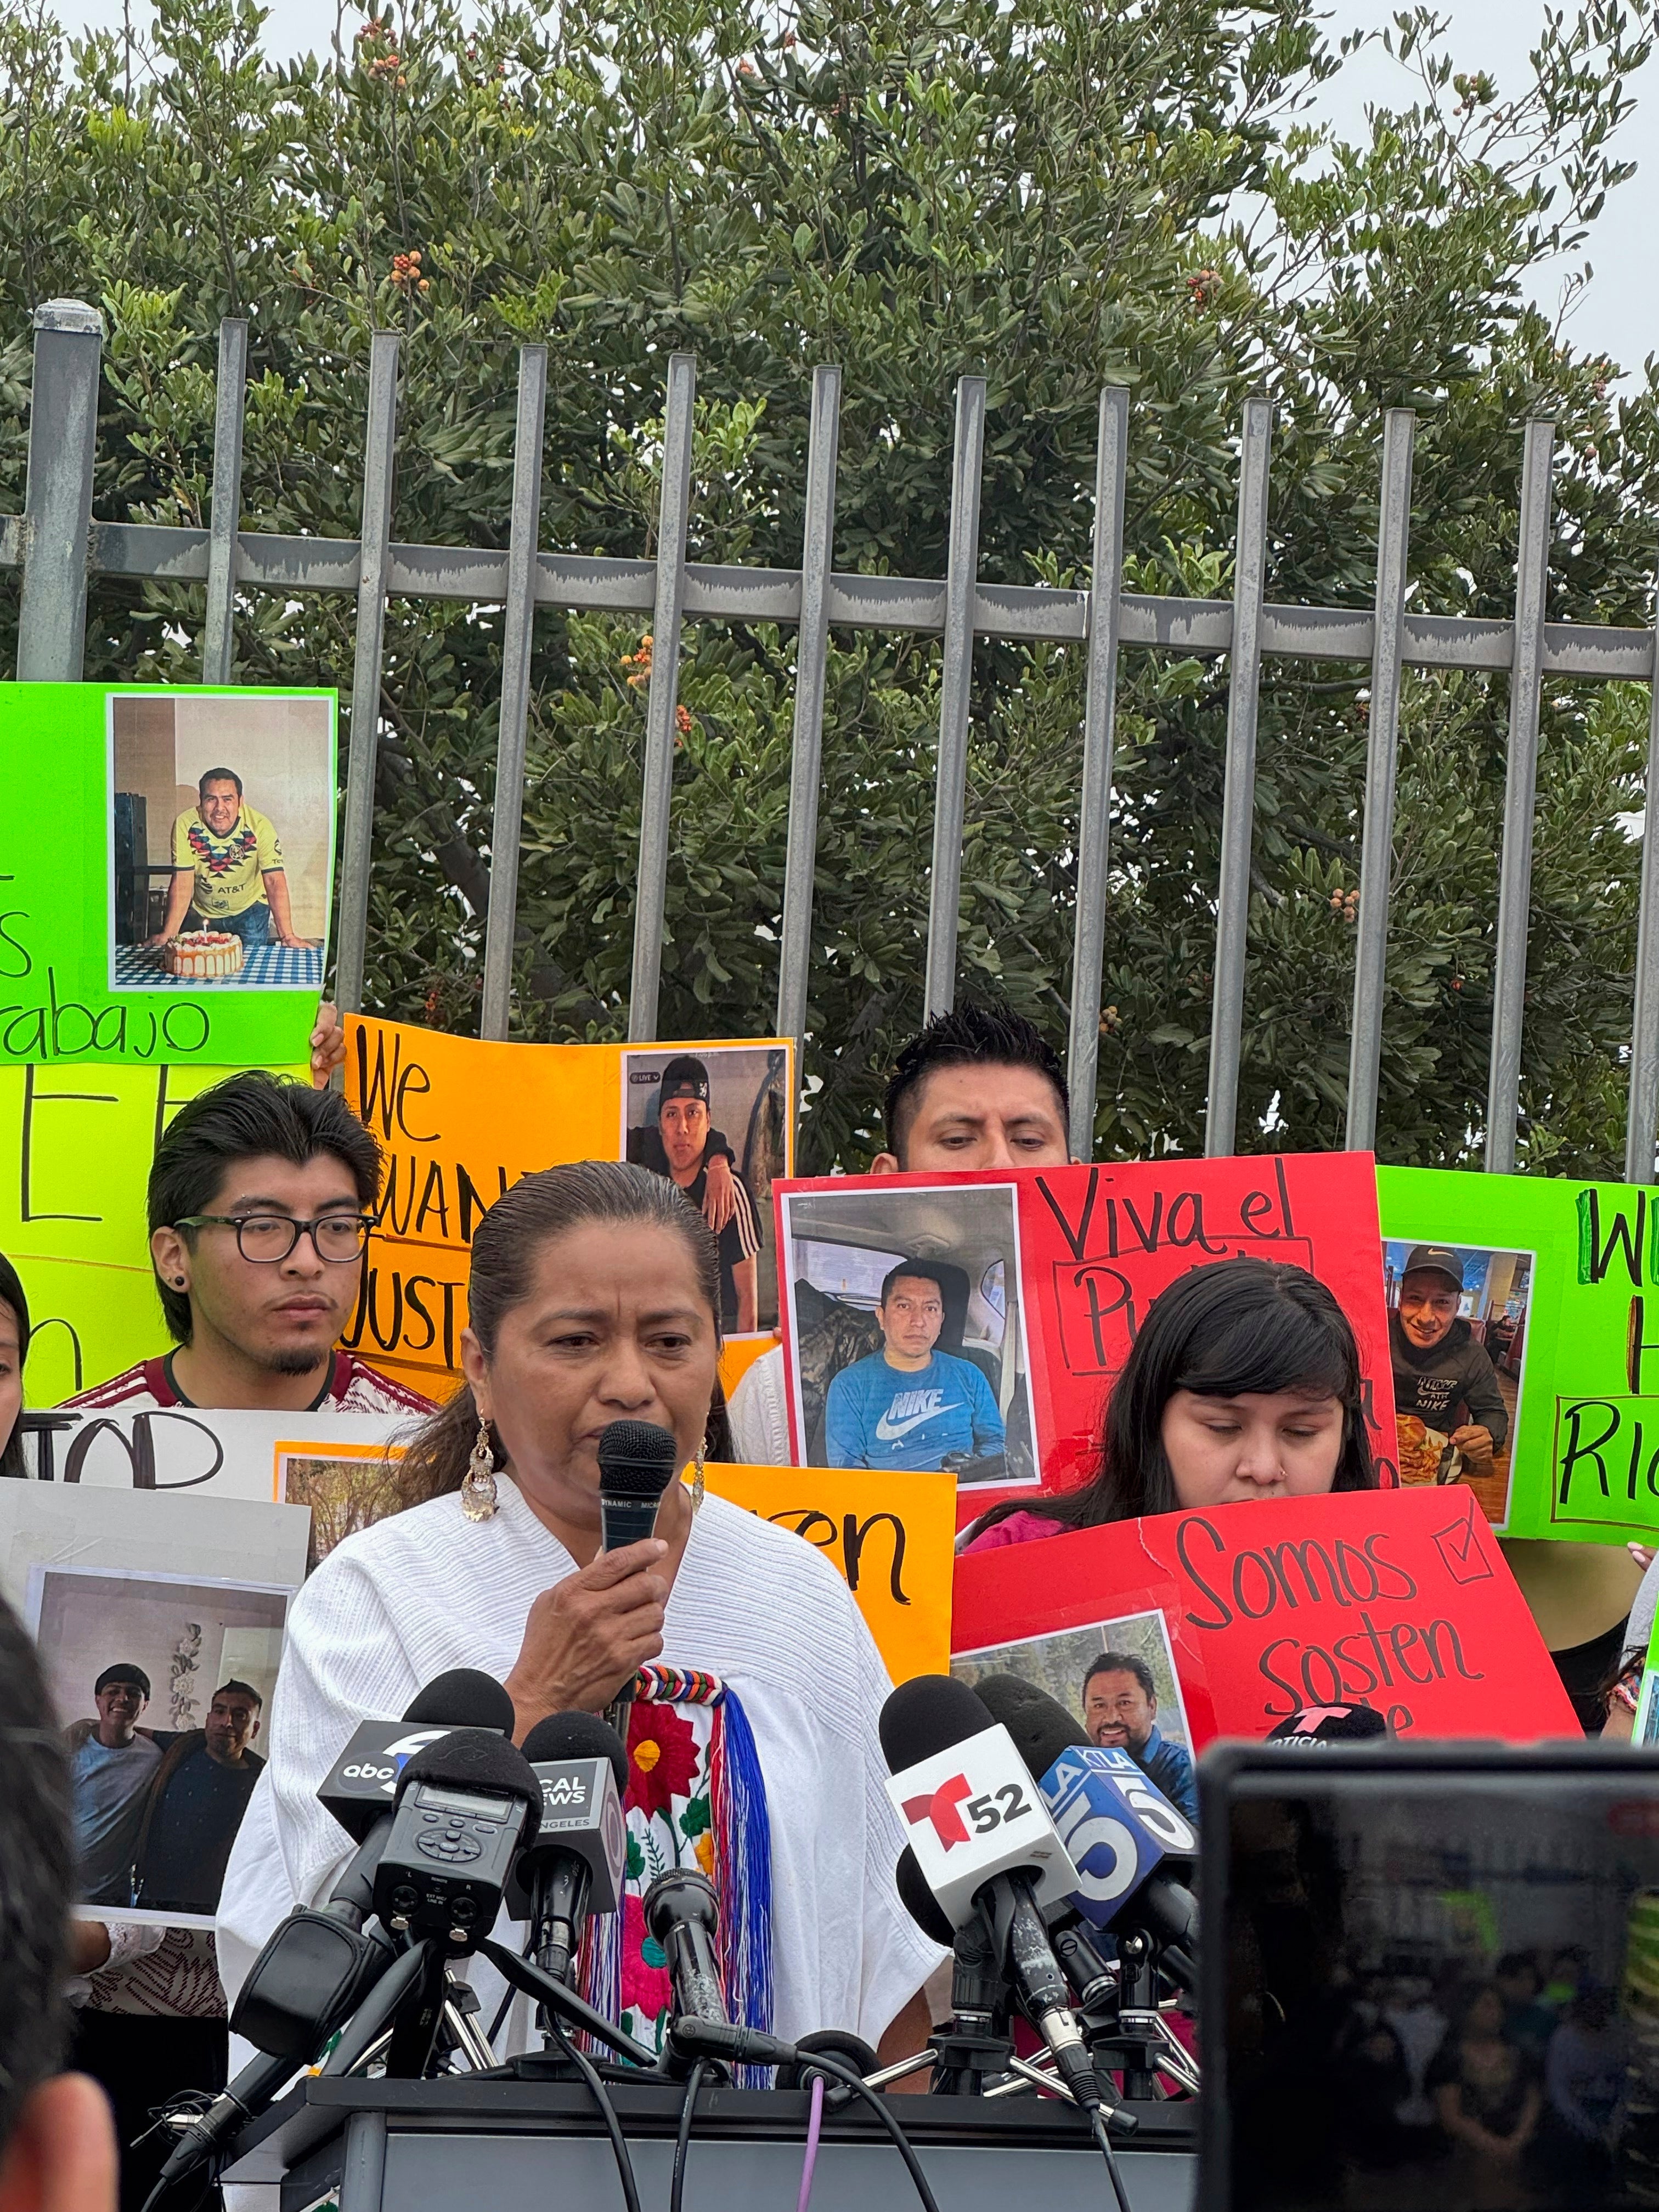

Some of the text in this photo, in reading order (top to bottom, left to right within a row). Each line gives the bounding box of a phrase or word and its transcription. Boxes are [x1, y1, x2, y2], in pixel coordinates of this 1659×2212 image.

[217, 883, 246, 894] AT&T
[356, 1024, 441, 1142] We
[372, 1154, 543, 1244] WAN
[1035, 1157, 1294, 1261] Viva el
[888, 1389, 944, 1420] NIKE
[1416, 1399, 1451, 1411] NIKE
[1176, 1516, 1418, 1630] Somos
[343, 1763, 394, 1780] abc
[1076, 1748, 1138, 1770] KTLA
[966, 1783, 1032, 1834] 52
[1111, 1776, 1195, 1849] 5
